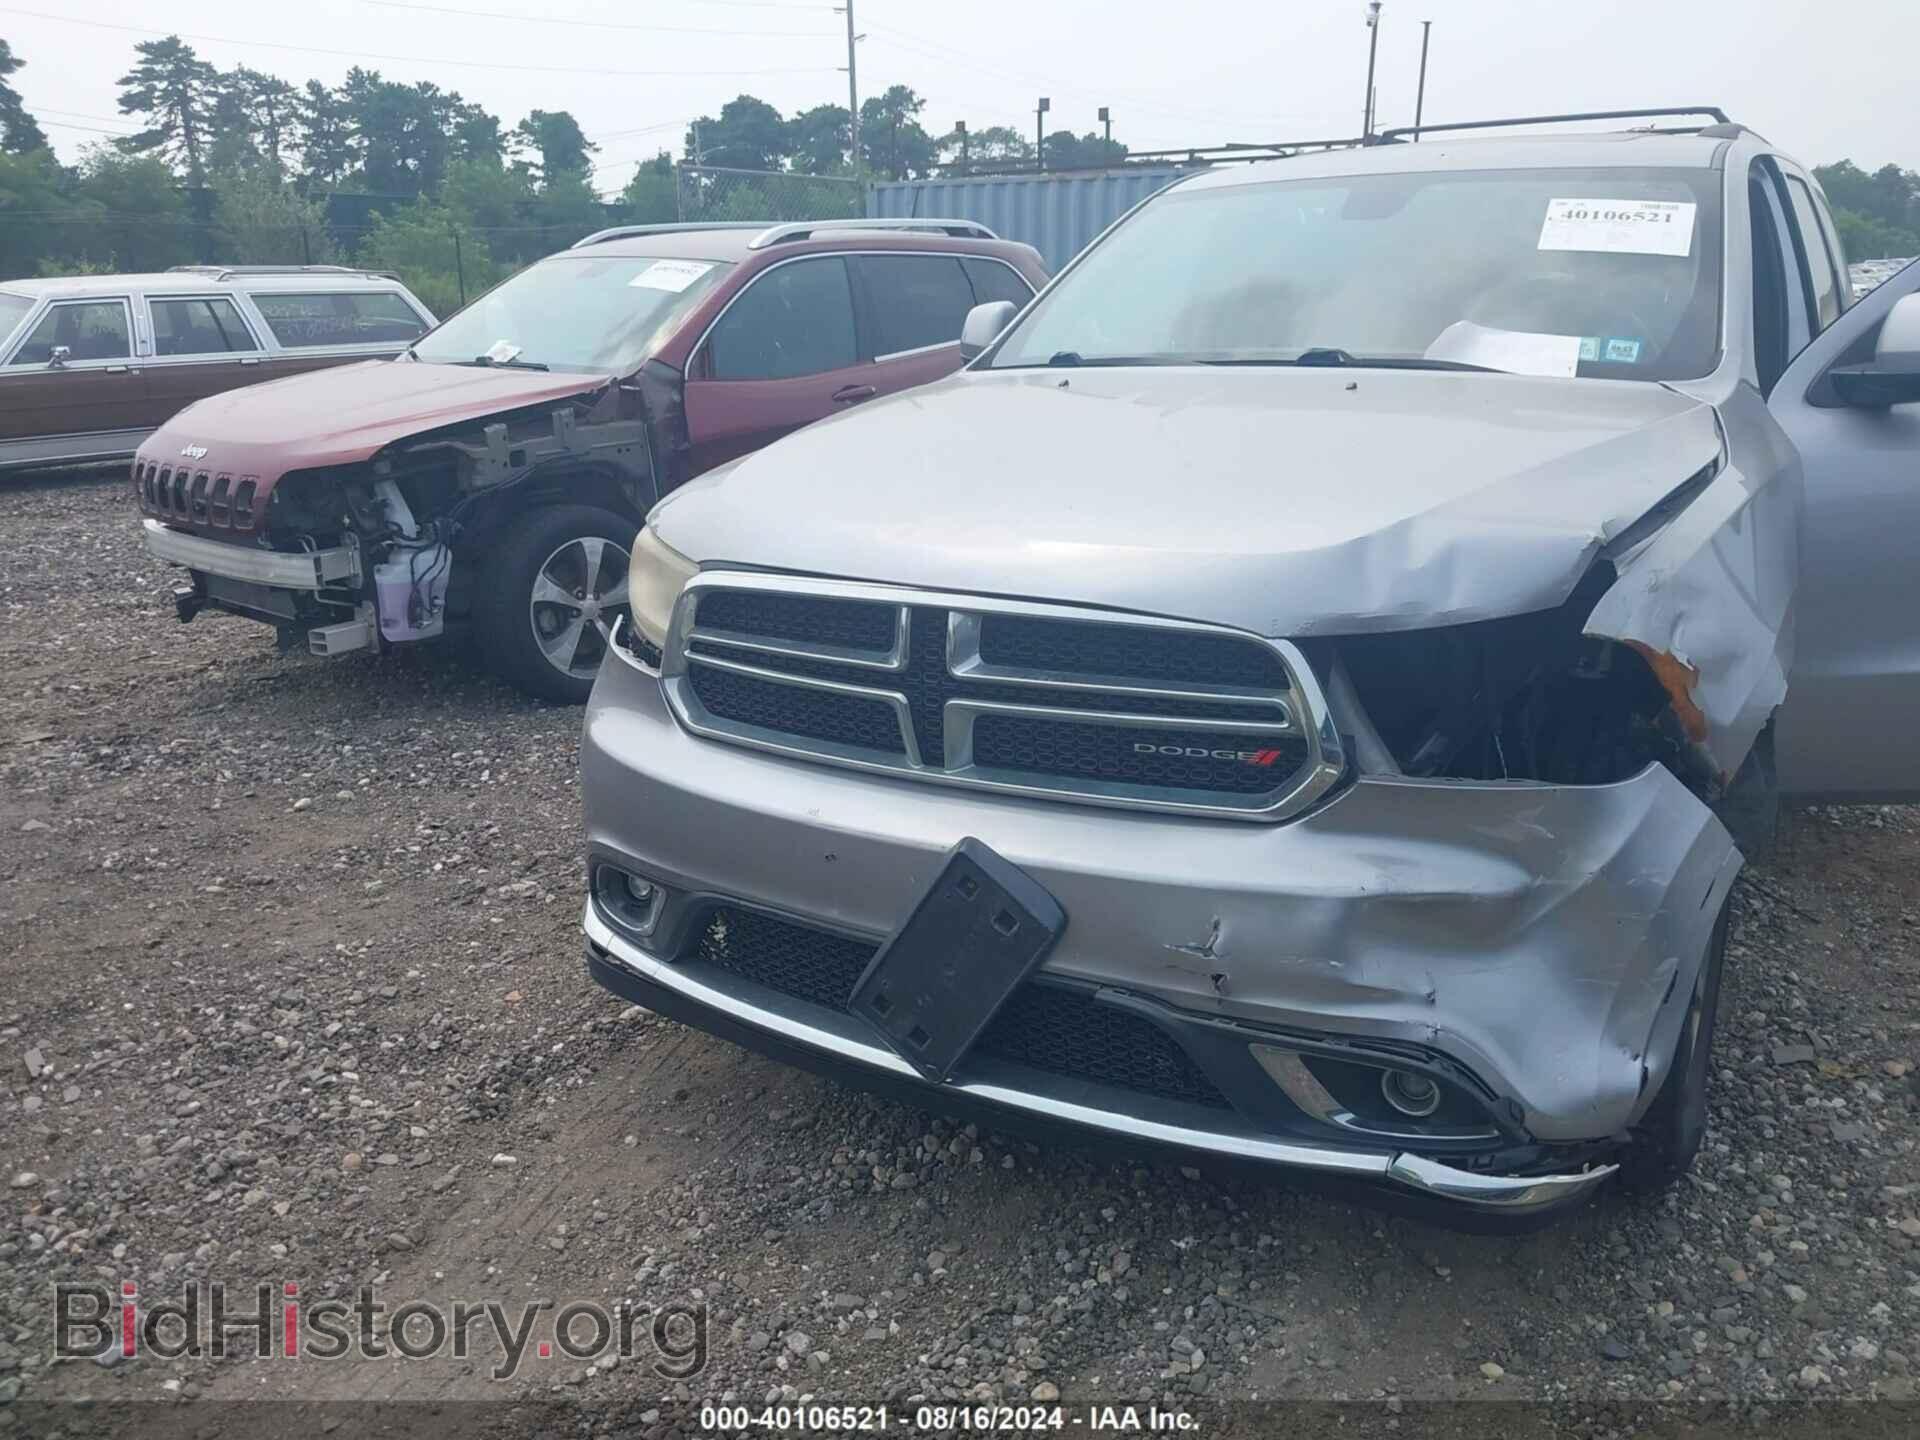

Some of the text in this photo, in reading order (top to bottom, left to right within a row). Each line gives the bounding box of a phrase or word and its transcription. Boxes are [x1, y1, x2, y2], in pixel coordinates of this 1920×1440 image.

[1561, 208, 1672, 223] 40106521
[181, 443, 208, 460] Jeep
[1134, 743, 1259, 760] DODGE
